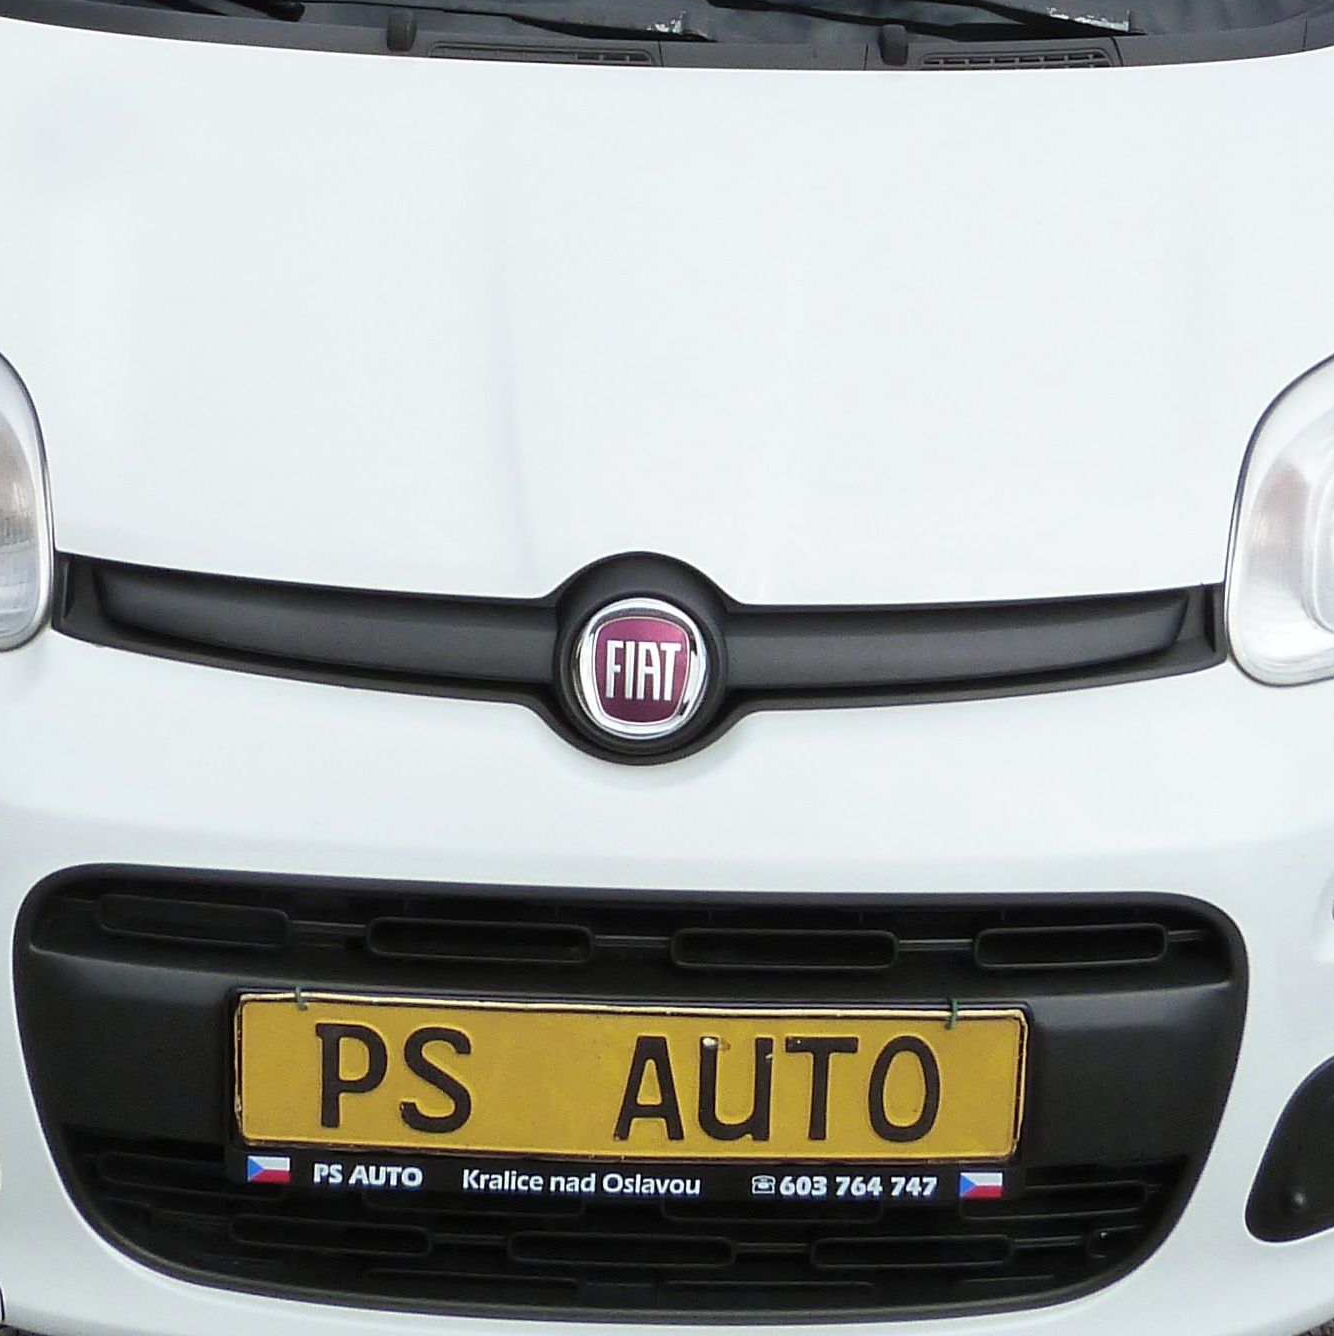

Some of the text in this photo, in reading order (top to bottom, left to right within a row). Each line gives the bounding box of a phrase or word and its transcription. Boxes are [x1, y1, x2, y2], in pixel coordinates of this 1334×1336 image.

[605, 639, 682, 701] FIAT
[314, 1021, 942, 1142] PS AUTO
[313, 1163, 938, 1196] PS AUTO Kralice nad Oslavou 603 764 747
